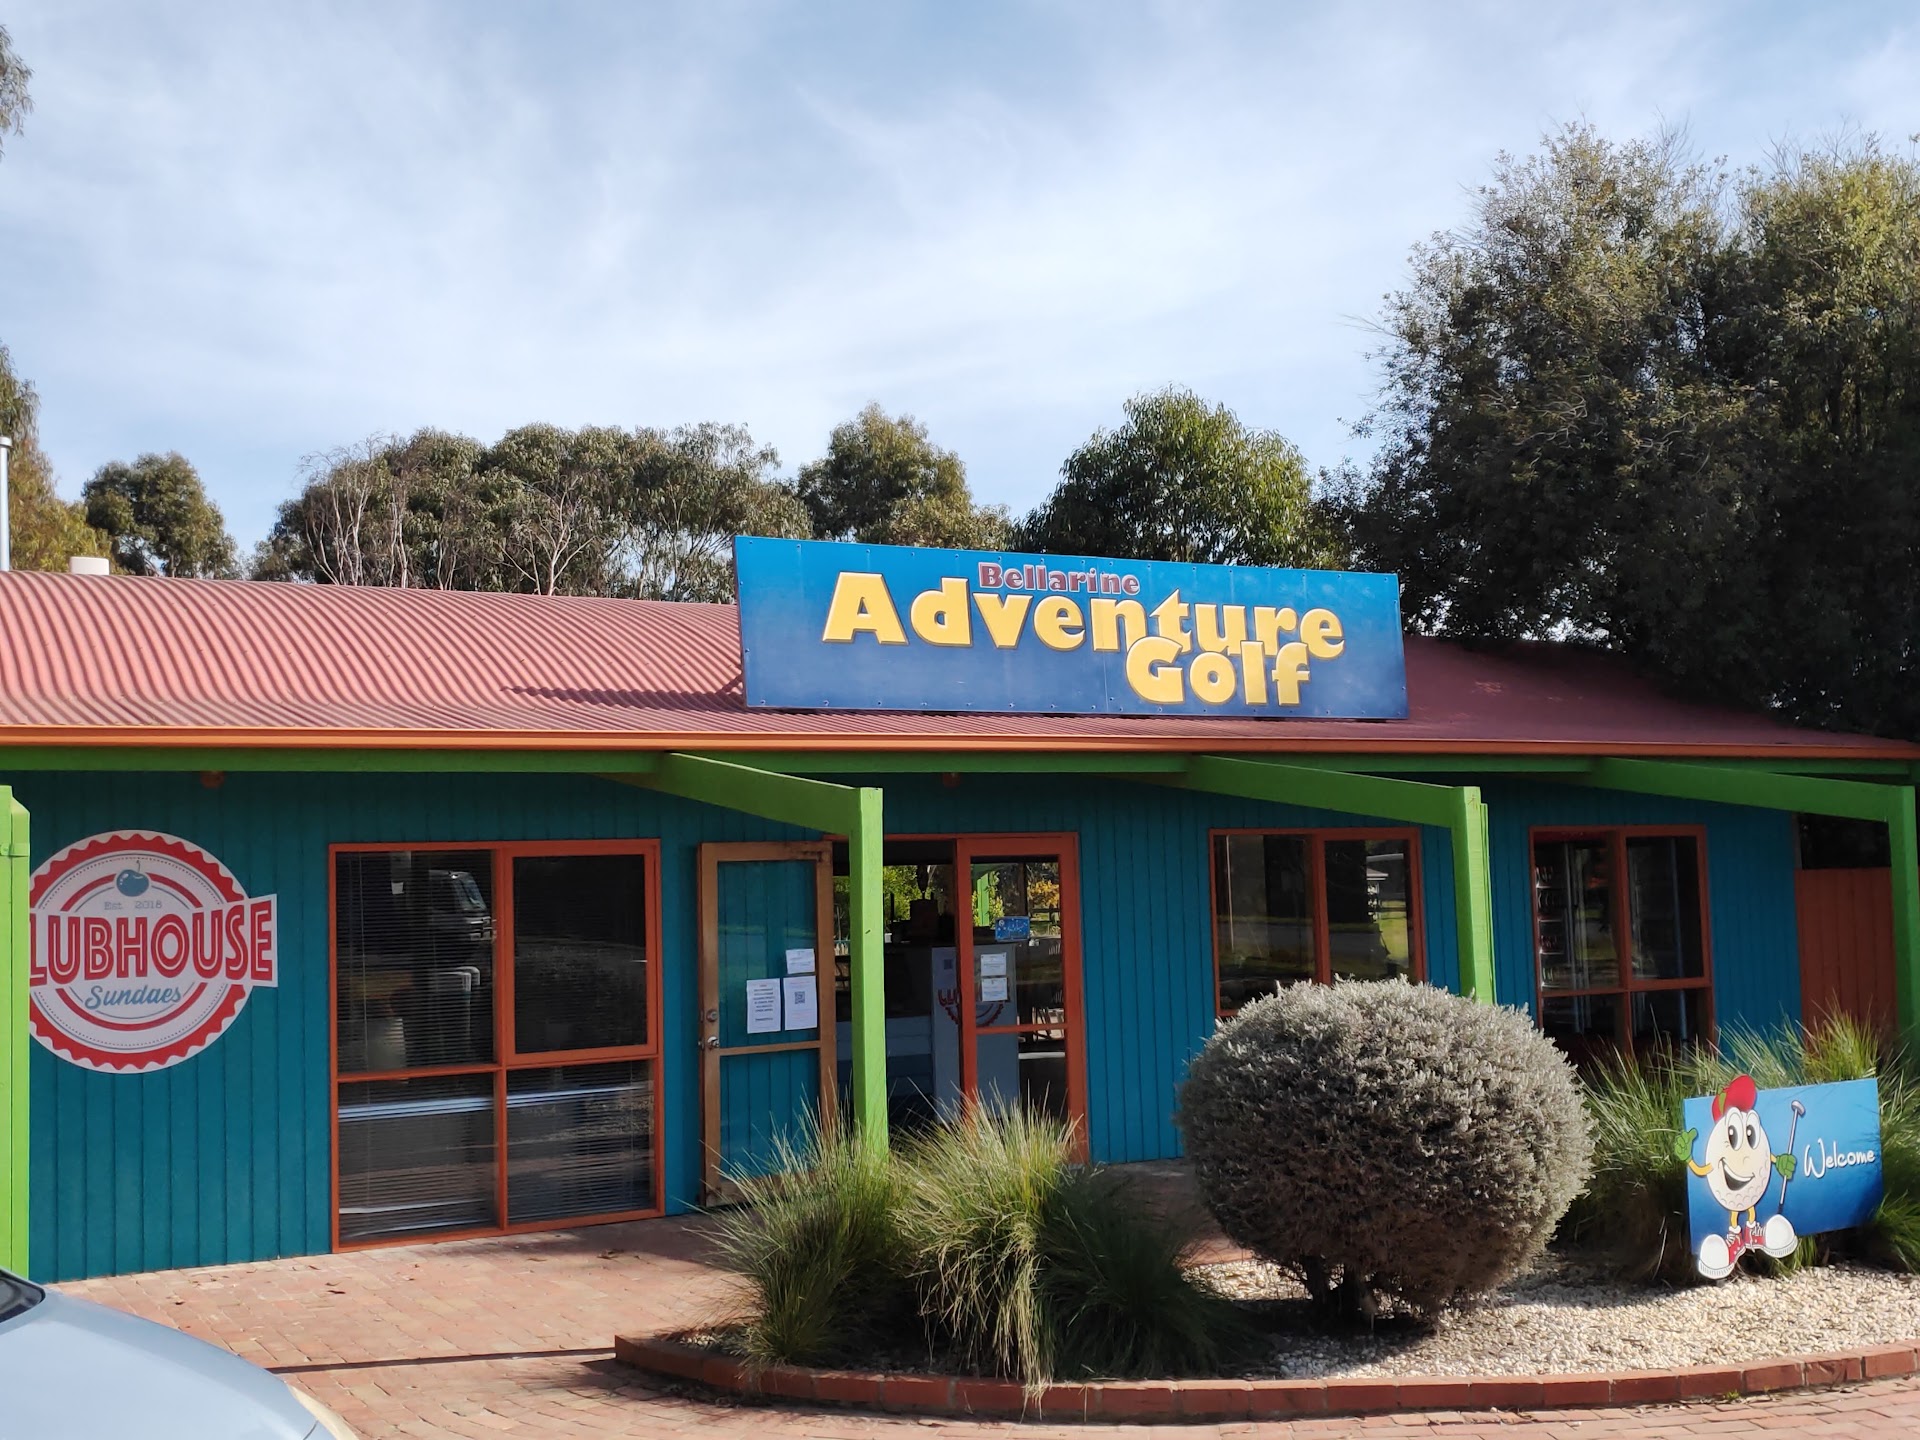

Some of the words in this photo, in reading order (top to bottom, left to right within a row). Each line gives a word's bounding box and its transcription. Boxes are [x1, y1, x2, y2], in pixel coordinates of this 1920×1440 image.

[977, 561, 1141, 596] Bellarine
[822, 572, 1346, 660] Adventure
[1126, 636, 1312, 706] Golf
[103, 901, 123, 911] Est
[134, 899, 163, 910] 2018
[30, 900, 273, 985] LUBHOUSE
[84, 985, 182, 1010] Sundaes
[1803, 1138, 1876, 1179] Welcome
